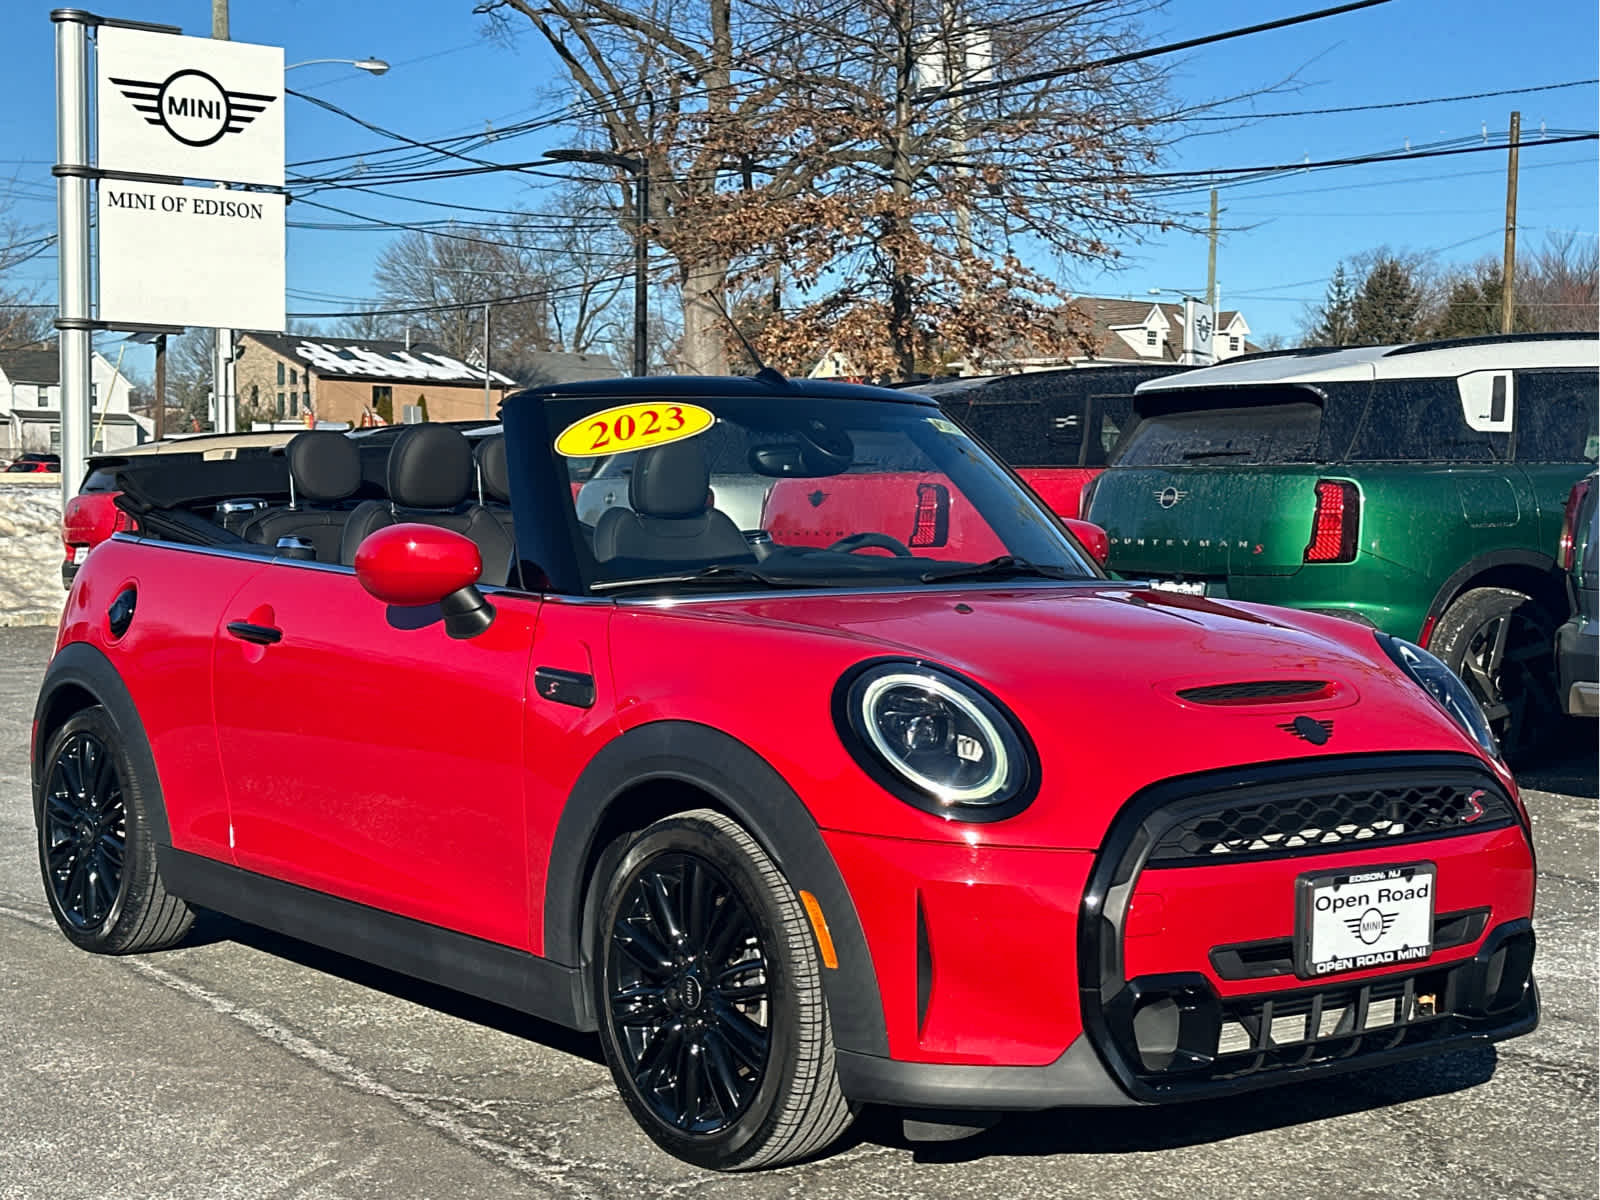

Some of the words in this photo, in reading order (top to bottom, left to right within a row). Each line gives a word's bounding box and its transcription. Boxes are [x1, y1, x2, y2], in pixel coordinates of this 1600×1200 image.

[168, 96, 221, 120] MINI
[107, 191, 156, 211] MINI
[161, 195, 187, 213] OF
[192, 198, 263, 219] EDISON
[588, 406, 686, 451] 2023
[1109, 537, 1248, 548] OUNTRYMAN
[1462, 790, 1485, 822] S
[1315, 894, 1370, 914] Open
[1378, 884, 1429, 904] Road
[1362, 921, 1381, 932] MINI
[1316, 958, 1354, 974] OPEN
[1356, 952, 1394, 968] ROAD
[1397, 947, 1427, 962] MINI
